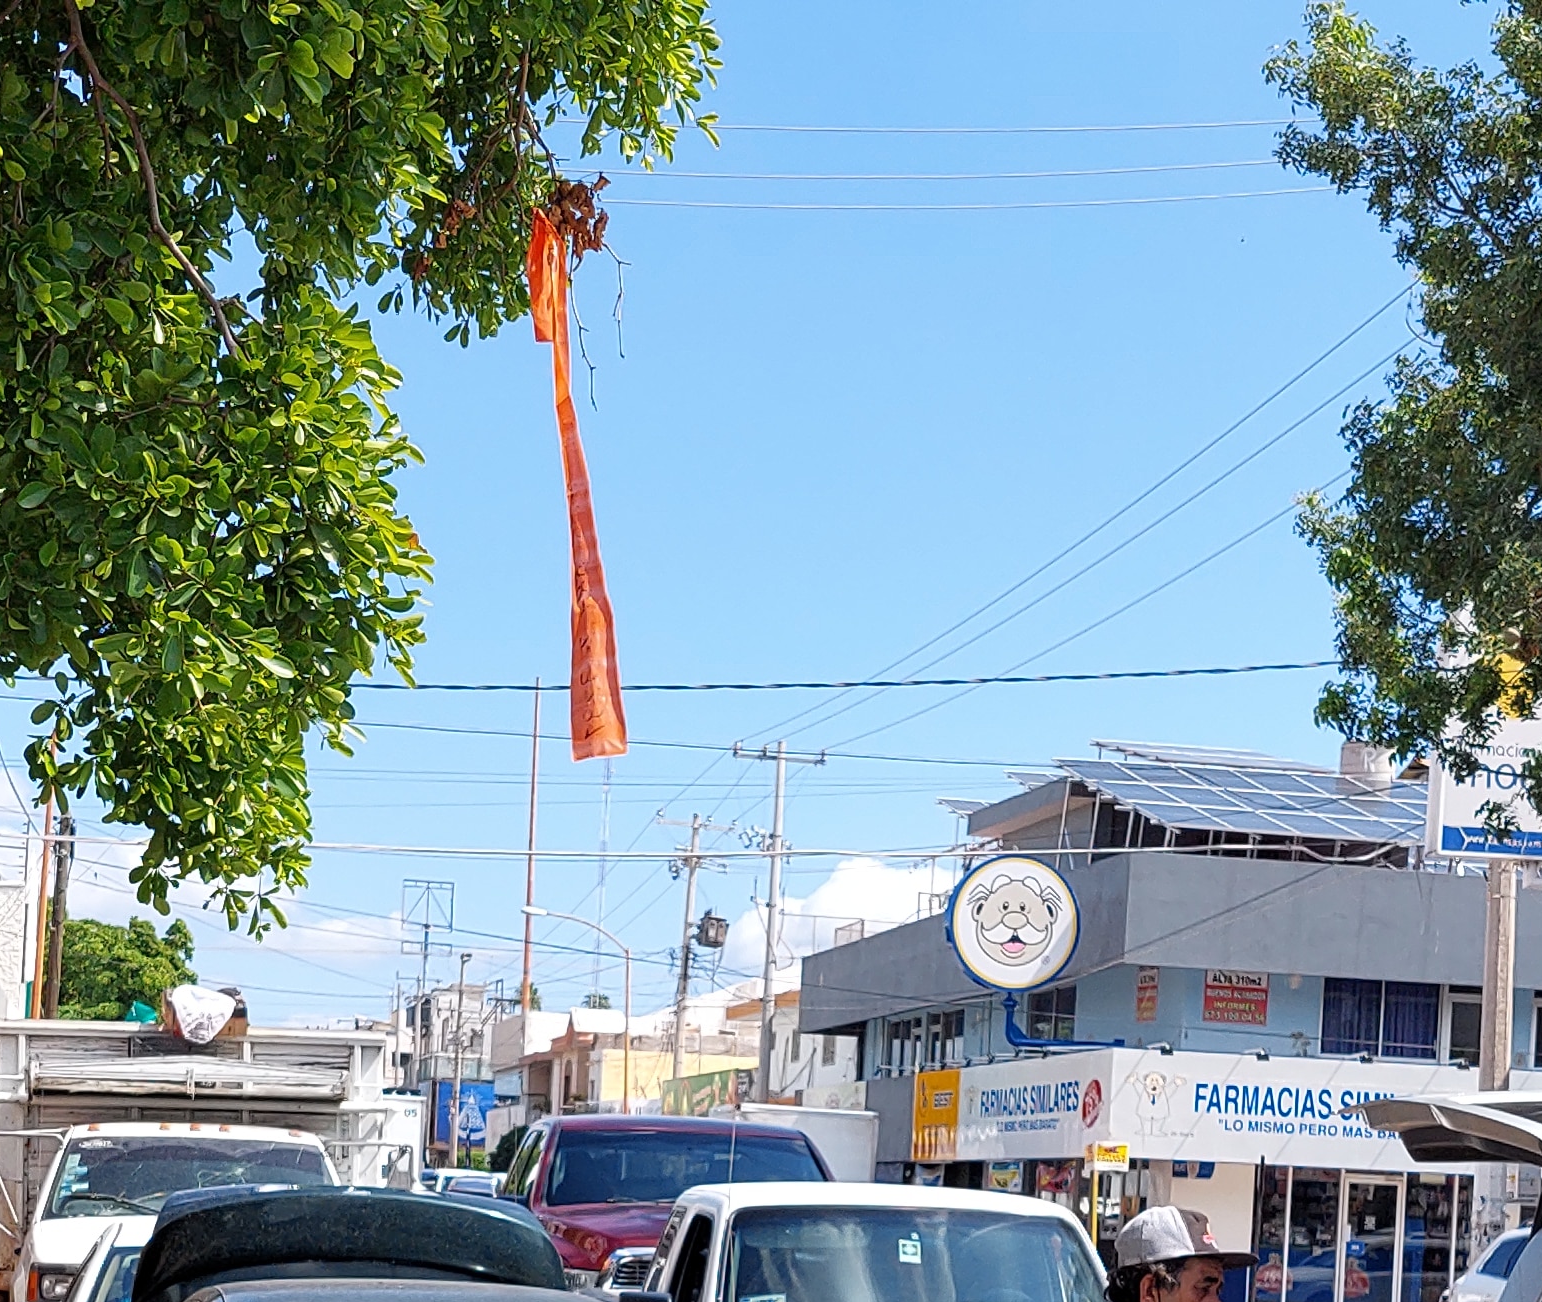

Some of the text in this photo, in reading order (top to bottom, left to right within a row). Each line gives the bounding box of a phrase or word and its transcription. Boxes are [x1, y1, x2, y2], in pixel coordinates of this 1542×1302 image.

[980, 1085, 1028, 1118] FARMACIAS
[1029, 1079, 1080, 1116] SIMILARES
[1194, 1082, 1332, 1120] FARMACIAS
[1247, 1121, 1295, 1135] MISMO
[1298, 1123, 1338, 1137] PERO
